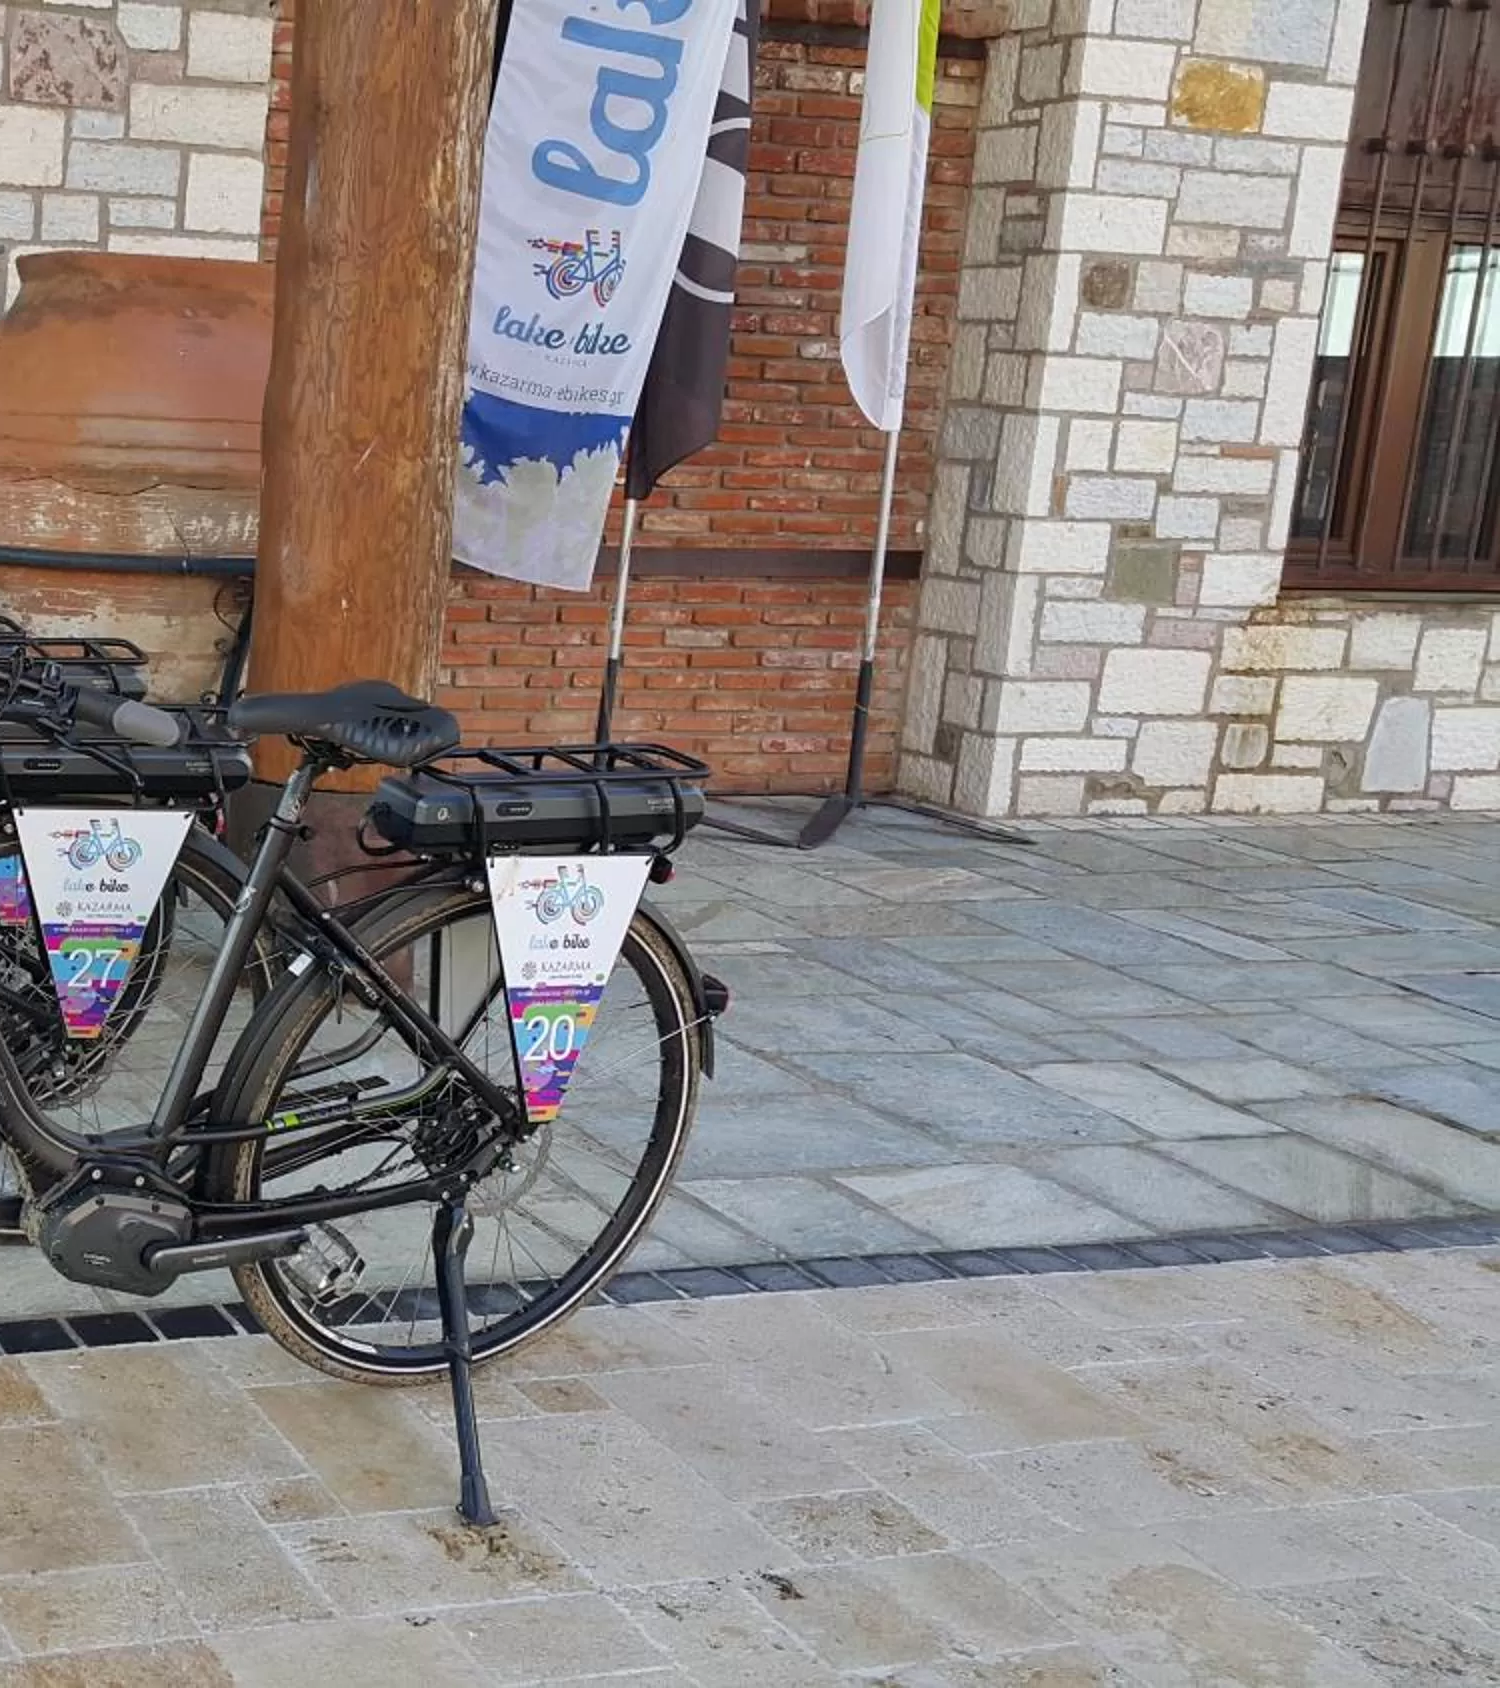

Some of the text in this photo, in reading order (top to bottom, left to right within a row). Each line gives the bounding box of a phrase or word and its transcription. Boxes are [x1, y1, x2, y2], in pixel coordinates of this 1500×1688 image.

[493, 305, 632, 354] lake bike
[67, 948, 122, 988] 27
[523, 1014, 575, 1061] 20
